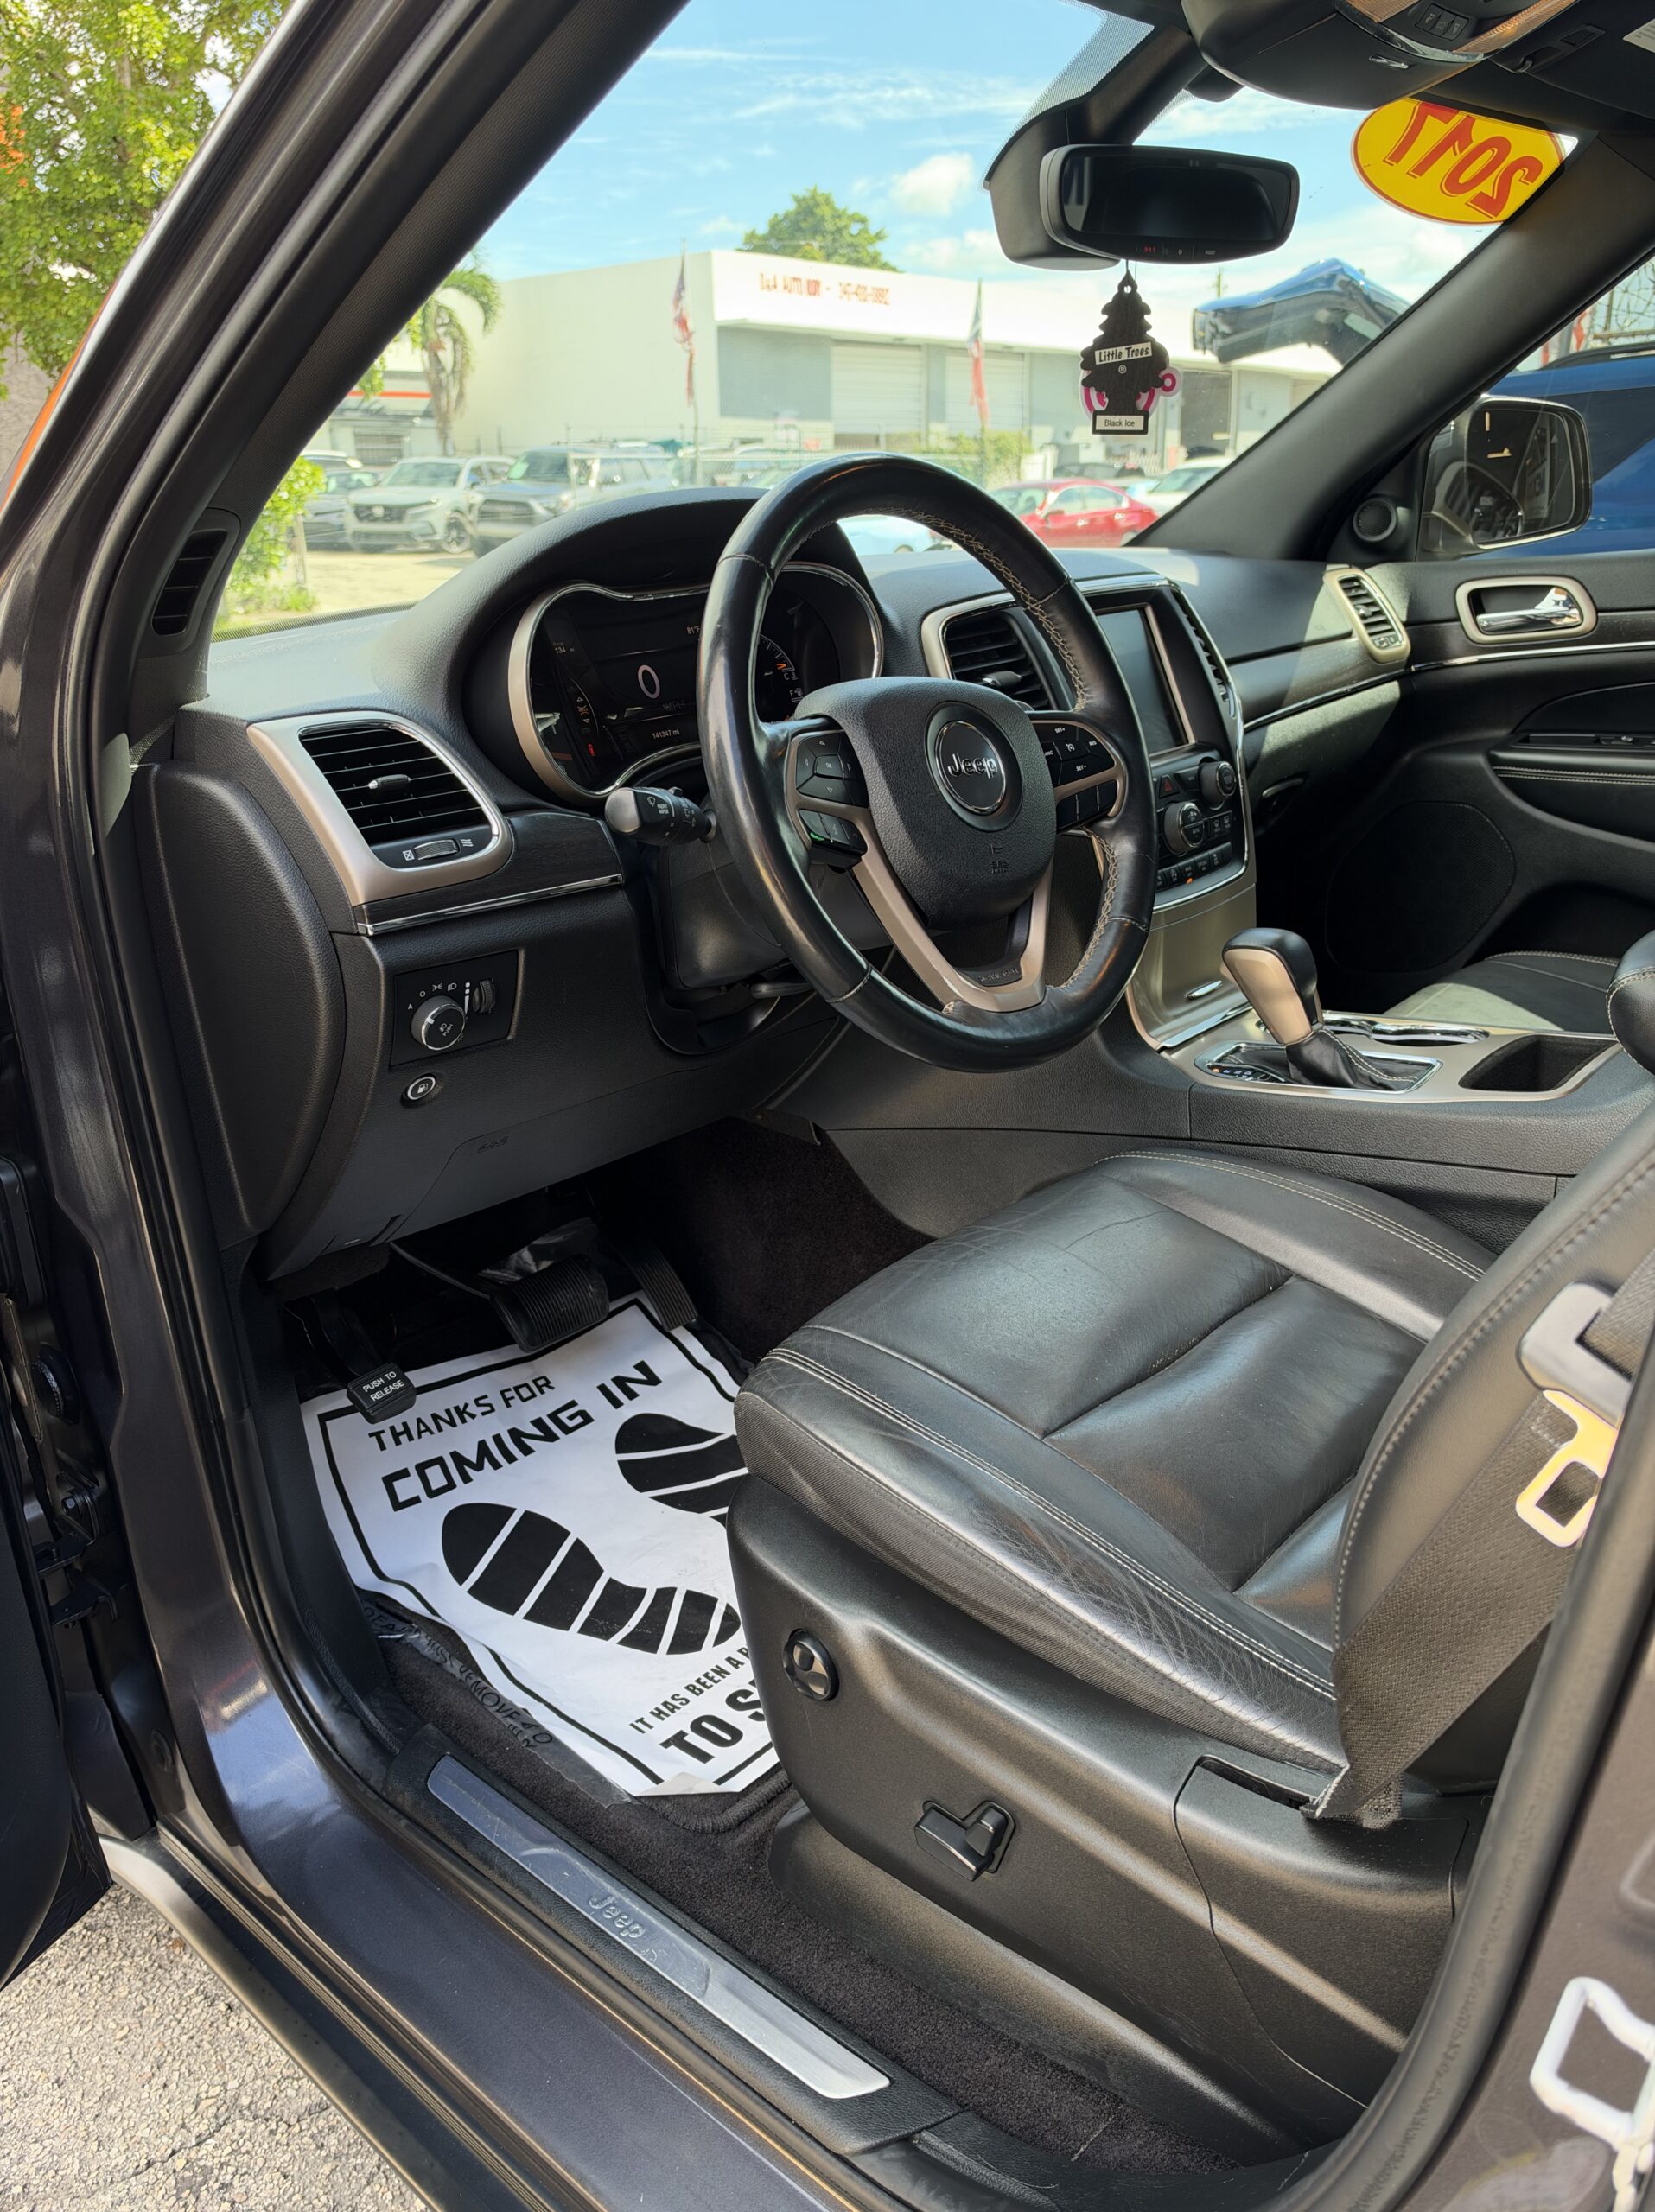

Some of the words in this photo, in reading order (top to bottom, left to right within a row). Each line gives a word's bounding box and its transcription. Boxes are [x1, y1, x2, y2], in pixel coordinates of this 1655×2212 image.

[1098, 348, 1123, 363] Little
[1125, 346, 1149, 358] Trees
[554, 646, 566, 655] 134
[638, 664, 660, 699] 0
[652, 729, 672, 740] 141347
[947, 753, 997, 779] Jeep
[442, 1023, 454, 1037] PUSH
[363, 1378, 385, 1392] PUSH
[385, 1371, 397, 1381] TO
[370, 1380, 404, 1402] RELEASE
[368, 1395, 496, 1452] THANKS
[500, 1375, 555, 1408] FOR
[381, 1400, 595, 1512] COMING
[596, 1360, 663, 1409] IN
[629, 1717, 654, 1734] IT
[649, 1693, 691, 1721] HAS
[684, 1664, 731, 1697] BEEN
[724, 1656, 745, 1669] A
[659, 1714, 743, 1764] TO
[589, 1895, 646, 1938] Jeep
